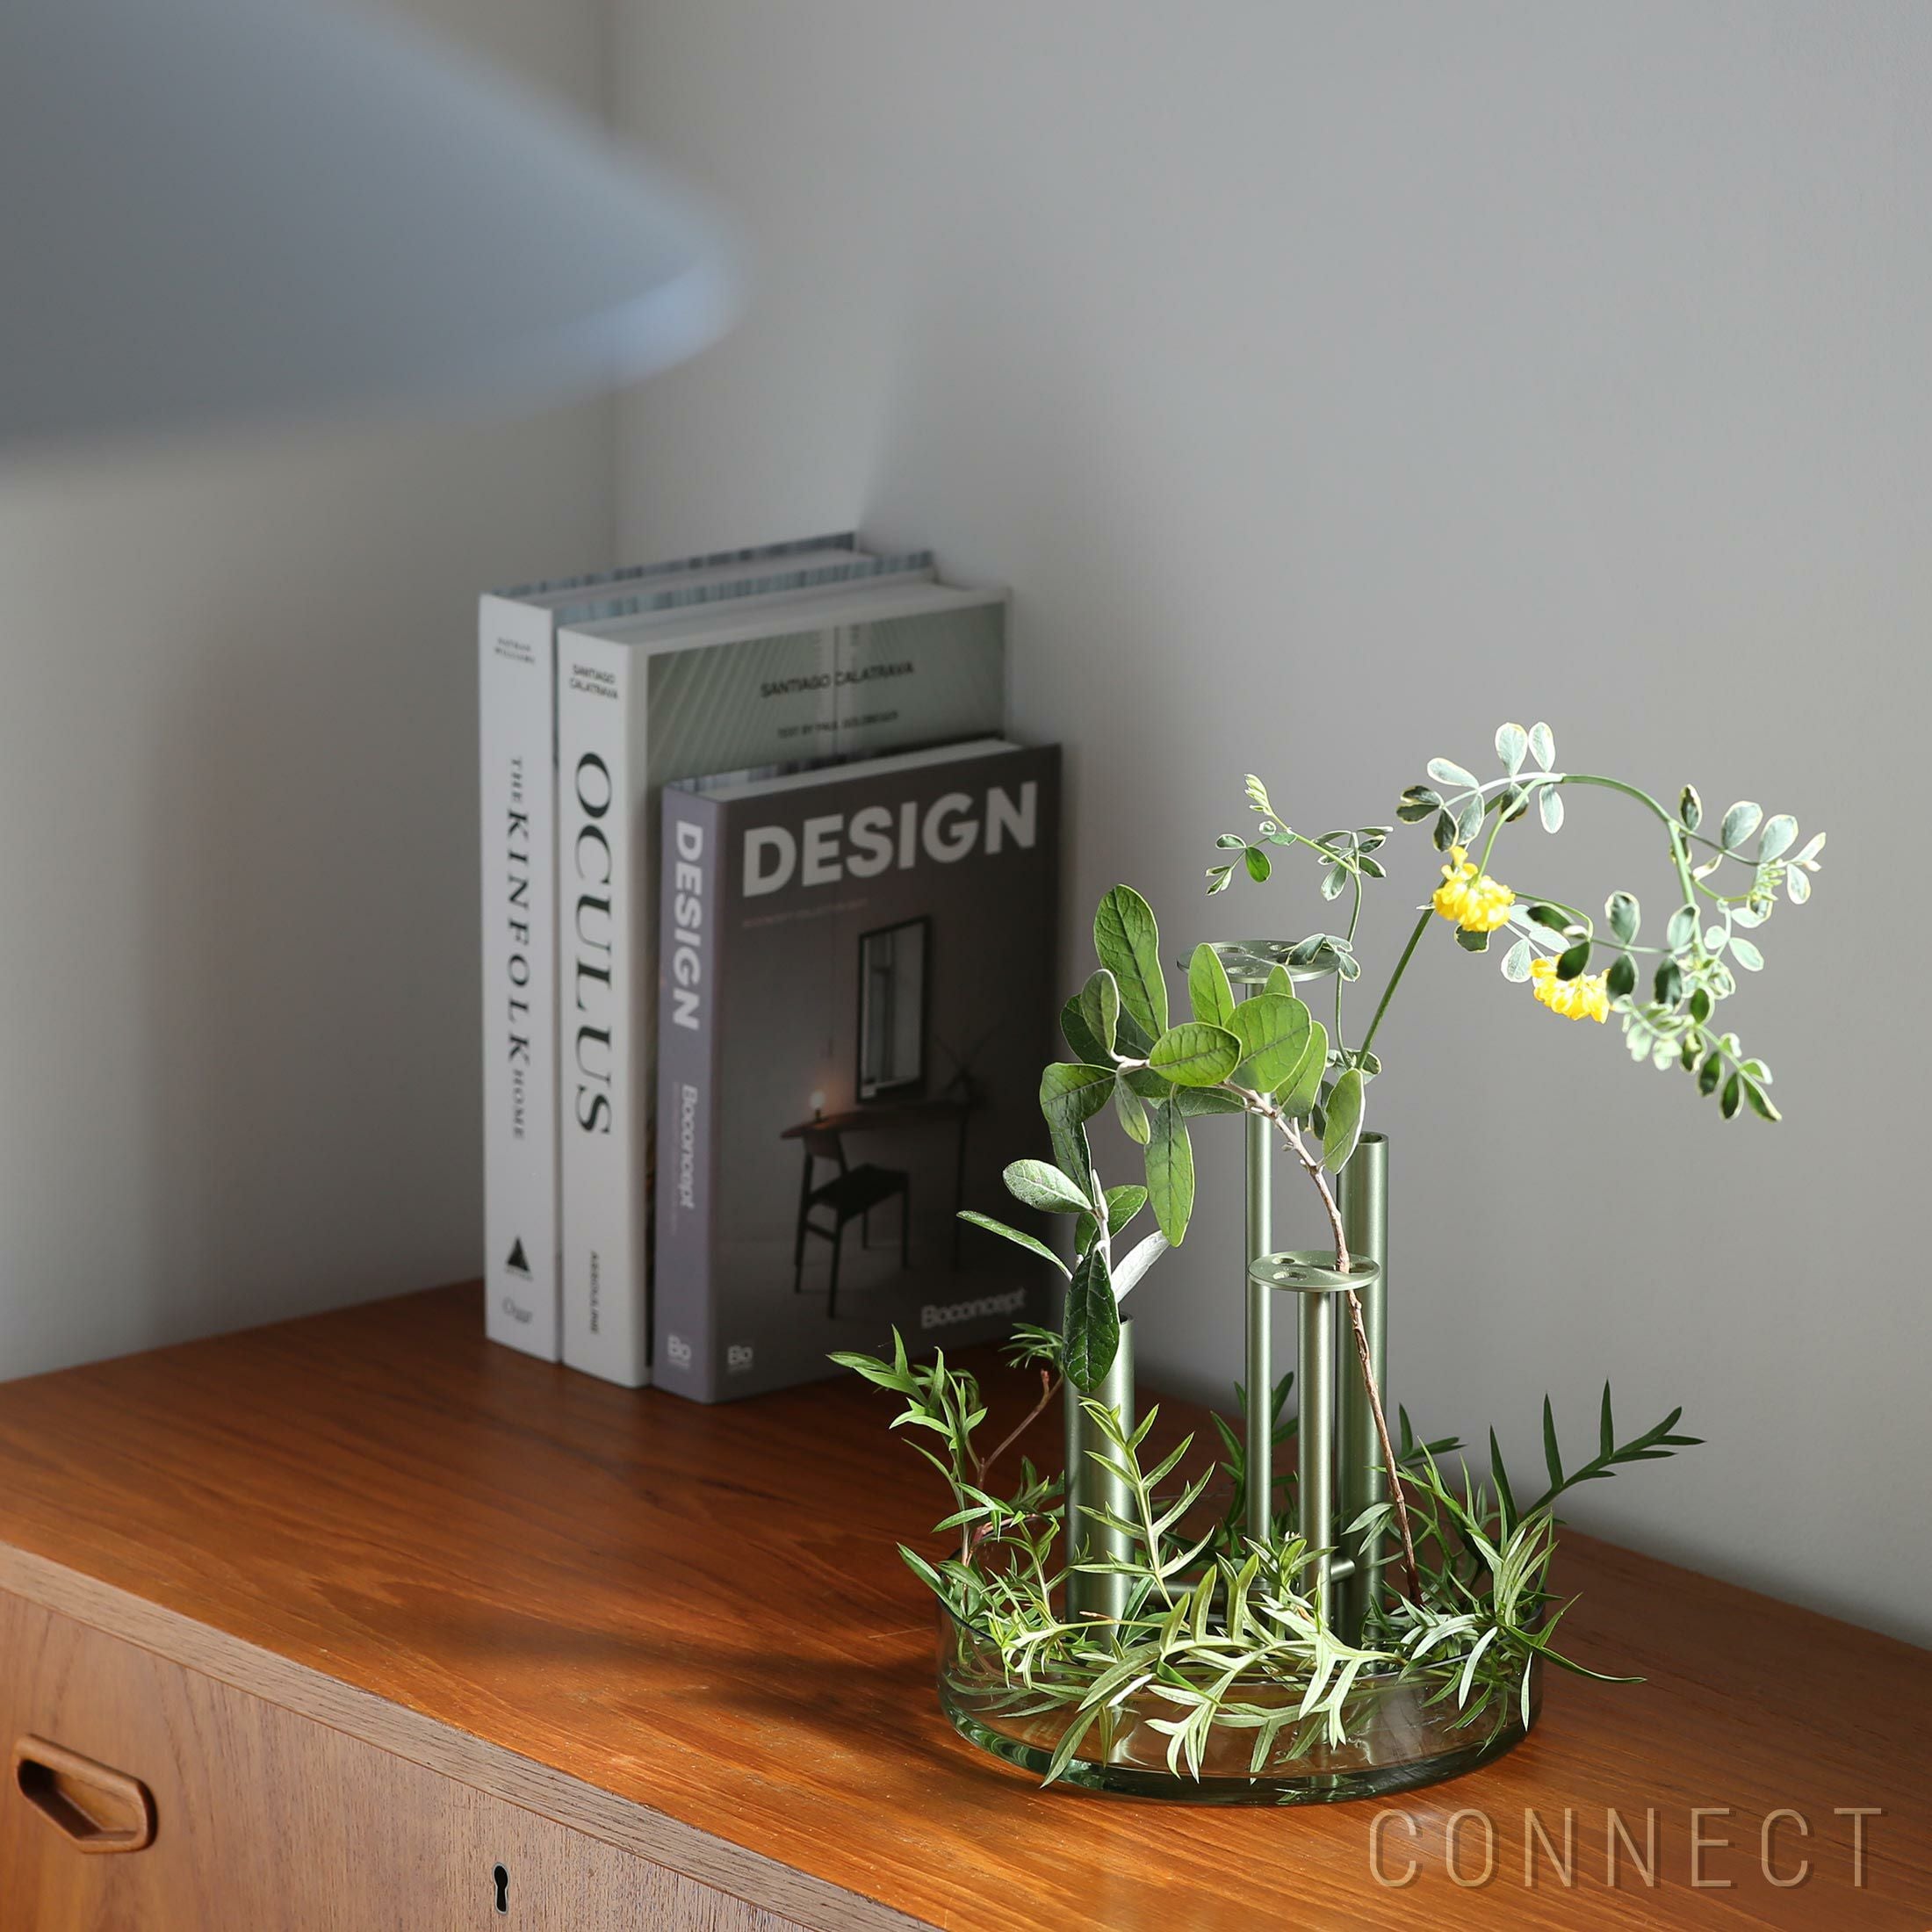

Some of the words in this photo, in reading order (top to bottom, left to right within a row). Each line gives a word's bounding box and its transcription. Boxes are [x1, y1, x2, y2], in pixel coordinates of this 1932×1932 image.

[761, 674, 832, 698] SANTIAGO
[834, 662, 914, 688] CALATRAVA
[510, 758, 523, 804] THE
[742, 781, 1038, 898] DESIGN
[508, 808, 531, 1066] KINFOLK
[573, 752, 613, 1136] OCULUS
[673, 819, 703, 1032] DESIGN
[513, 1068, 526, 1142] HOME
